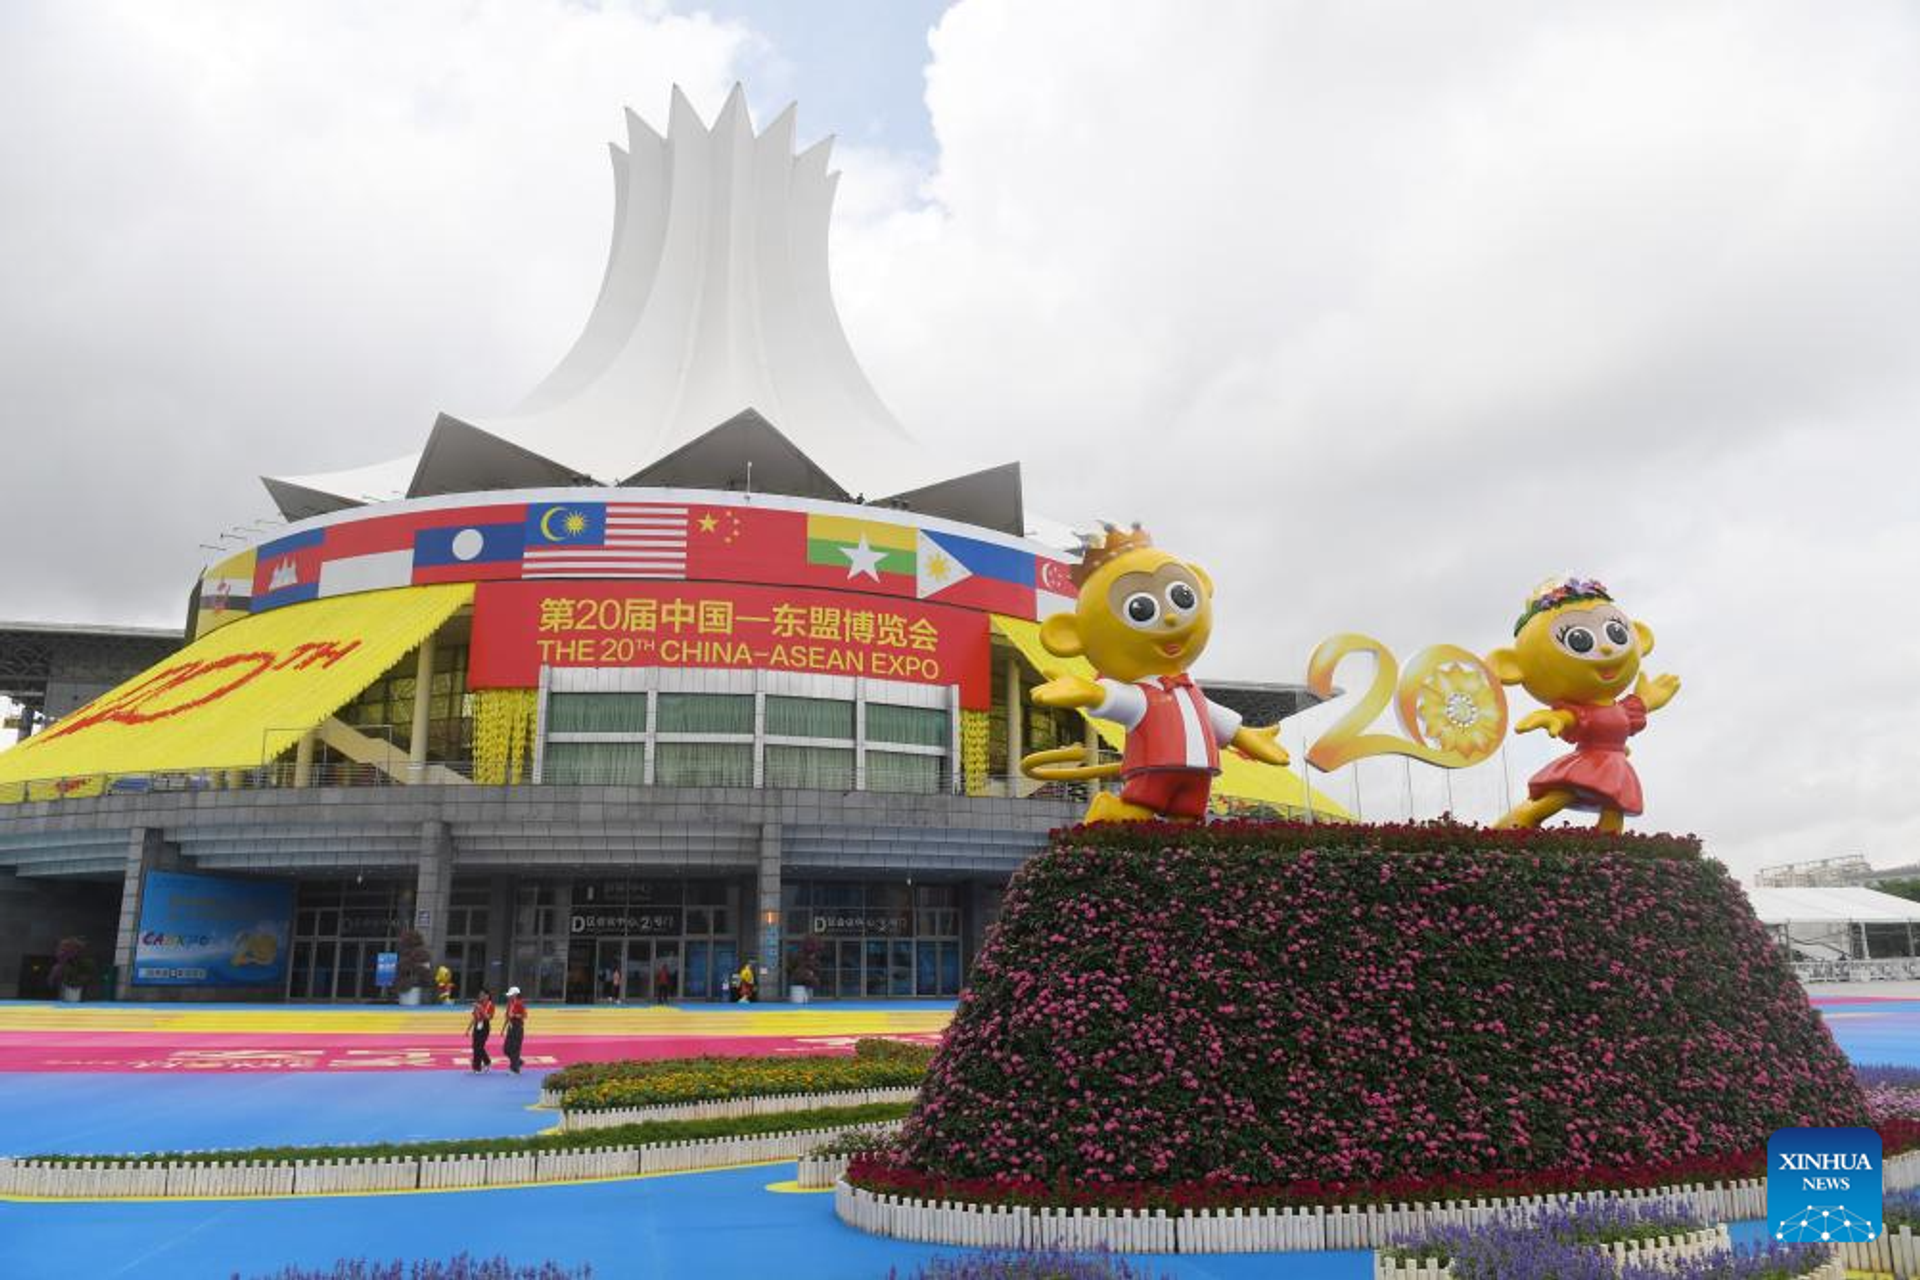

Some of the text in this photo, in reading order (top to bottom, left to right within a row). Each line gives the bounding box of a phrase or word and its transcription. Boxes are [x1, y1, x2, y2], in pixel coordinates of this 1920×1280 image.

[536, 639, 596, 662] THE
[600, 637, 656, 662] 20TH
[871, 652, 940, 681] EXPO
[1305, 632, 1508, 773] 20
